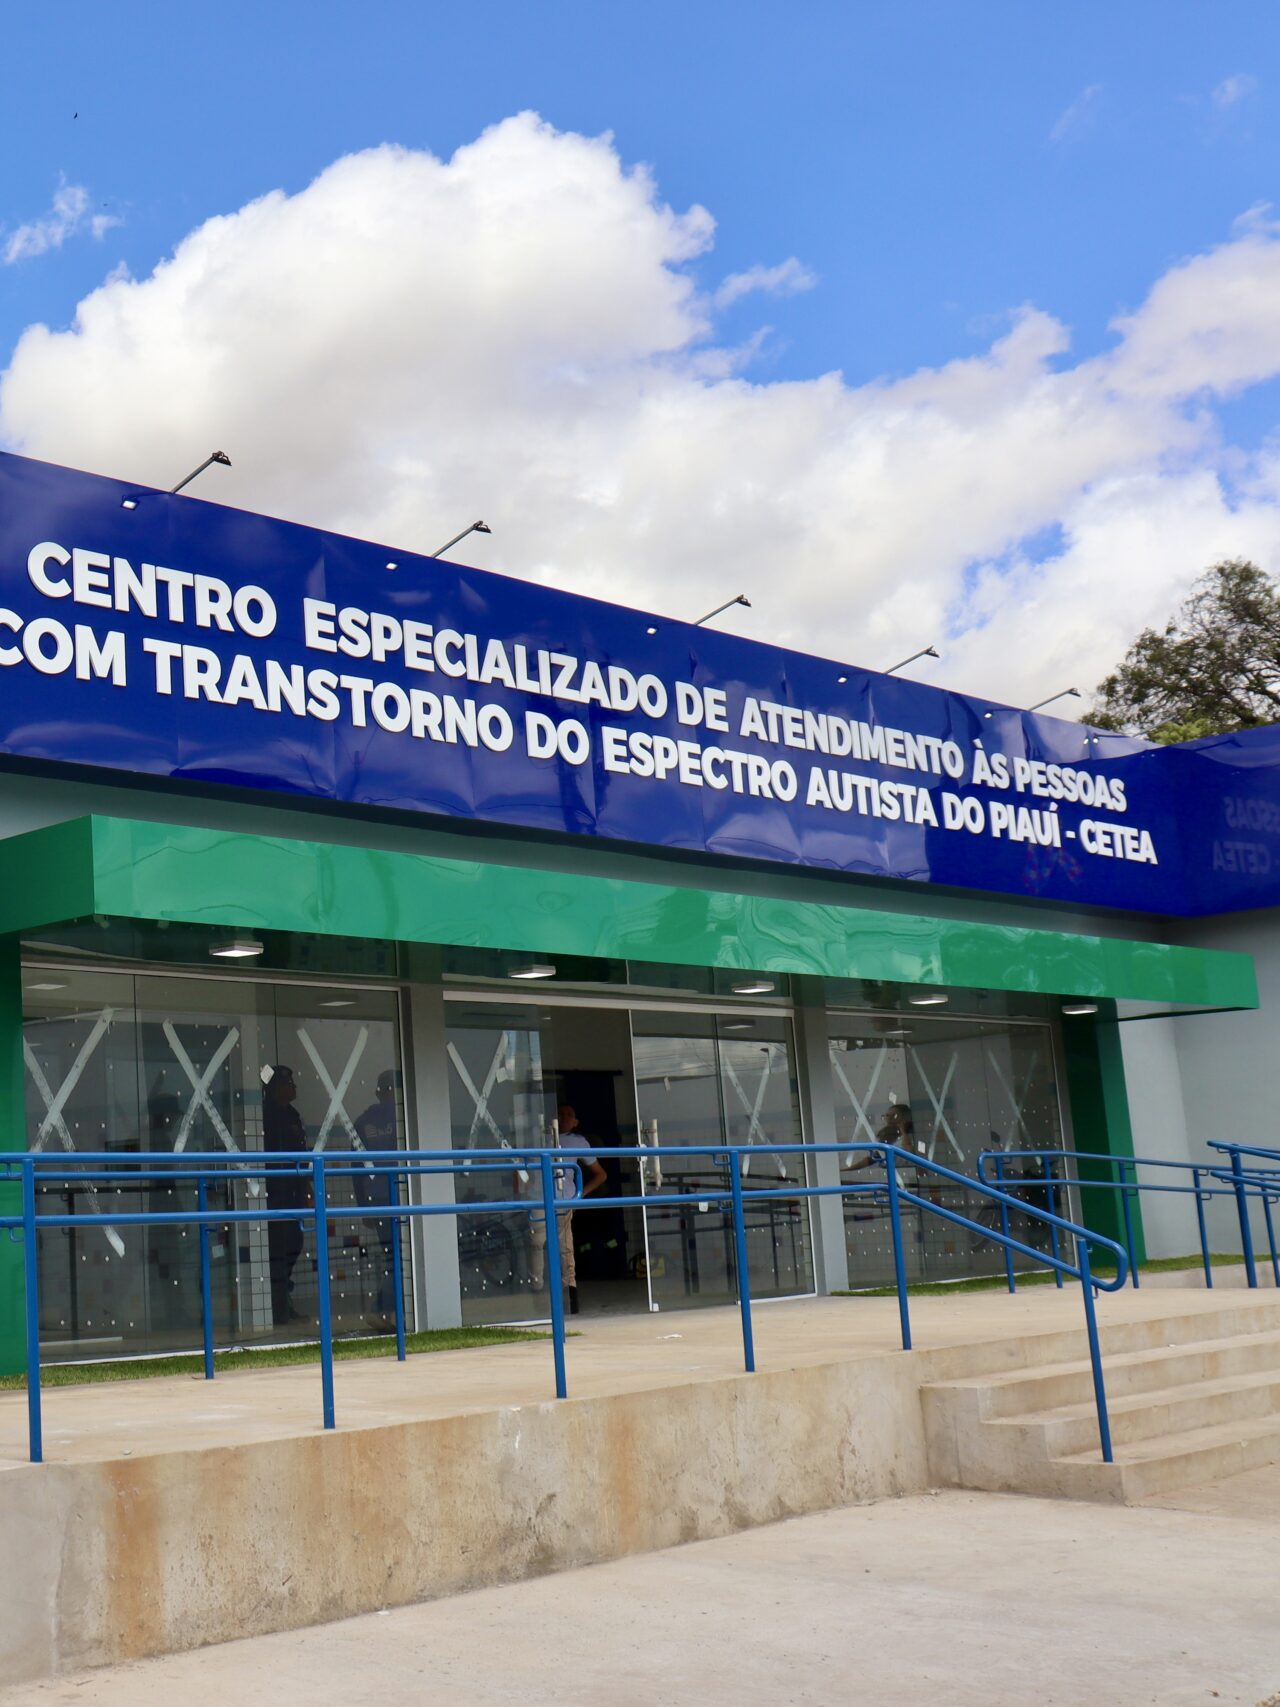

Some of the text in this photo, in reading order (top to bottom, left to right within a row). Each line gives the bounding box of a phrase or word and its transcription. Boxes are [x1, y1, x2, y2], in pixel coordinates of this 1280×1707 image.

[27, 541, 1127, 813] CENTRO ESPECIALIZADO DE ATENDIMENTO ÀS PESSOAS
[143, 636, 514, 753] TRANSTORNO
[525, 710, 589, 766] DO
[603, 726, 797, 802] ESPECTRO
[806, 766, 939, 828] AUTISTA
[943, 795, 985, 834] DO
[990, 802, 1063, 849] PIAUÍ
[1065, 830, 1075, 839] -
[1079, 823, 1158, 866] CETEA
